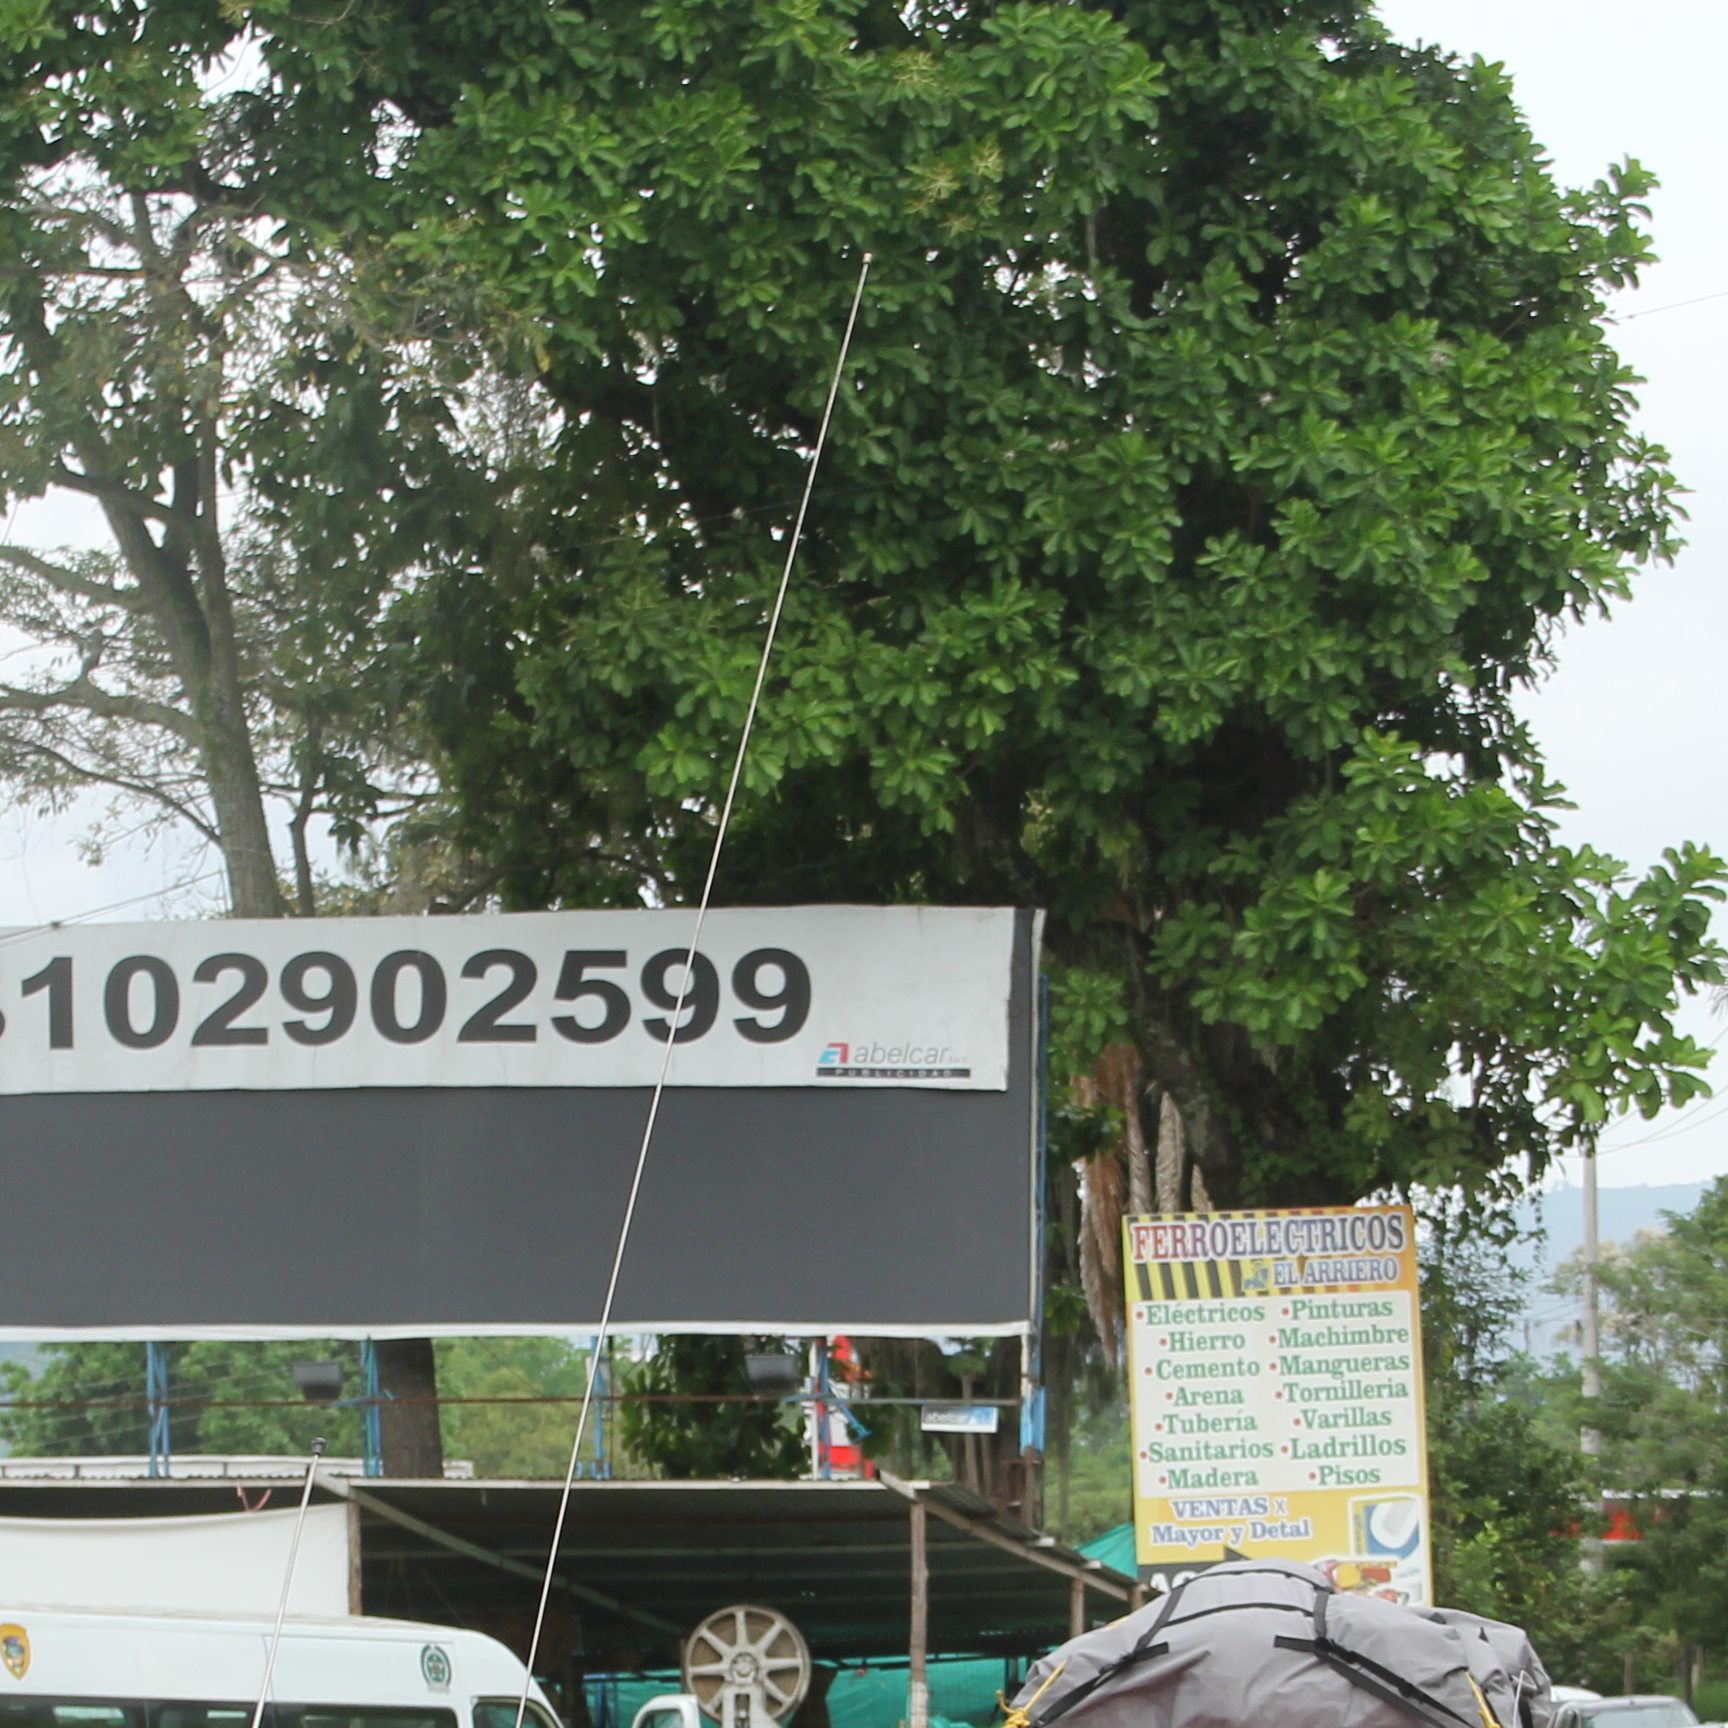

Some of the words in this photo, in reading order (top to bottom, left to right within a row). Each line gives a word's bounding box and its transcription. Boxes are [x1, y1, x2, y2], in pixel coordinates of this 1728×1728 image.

[853, 1042, 951, 1065] abelcar
[1132, 1214, 1404, 1260] FERROELECTRICOS
[1273, 1261, 1300, 1286] EL
[1302, 1257, 1398, 1284] ARRIERO
[1145, 1302, 1265, 1326] Eléctricos
[1290, 1299, 1393, 1321] Pinturas
[1168, 1330, 1246, 1352] Hierro
[1277, 1325, 1409, 1349] Machimbre
[1156, 1357, 1261, 1380] Cemento
[1278, 1353, 1410, 1379] Mangueras
[1173, 1386, 1245, 1407] Arena
[1282, 1378, 1409, 1403] Tornilleria
[1163, 1409, 1258, 1435] Tubería
[1300, 1406, 1392, 1430] Varillas
[1148, 1438, 1274, 1463] Sanitarios
[1289, 1434, 1407, 1460] Ladrillos
[1167, 1467, 1259, 1490] Madera
[1318, 1464, 1381, 1486] Pisos
[1171, 1497, 1269, 1519] VENTAS
[1151, 1524, 1225, 1547] Mayor
[1230, 1525, 1244, 1544] y
[1250, 1519, 1311, 1540] Detal
